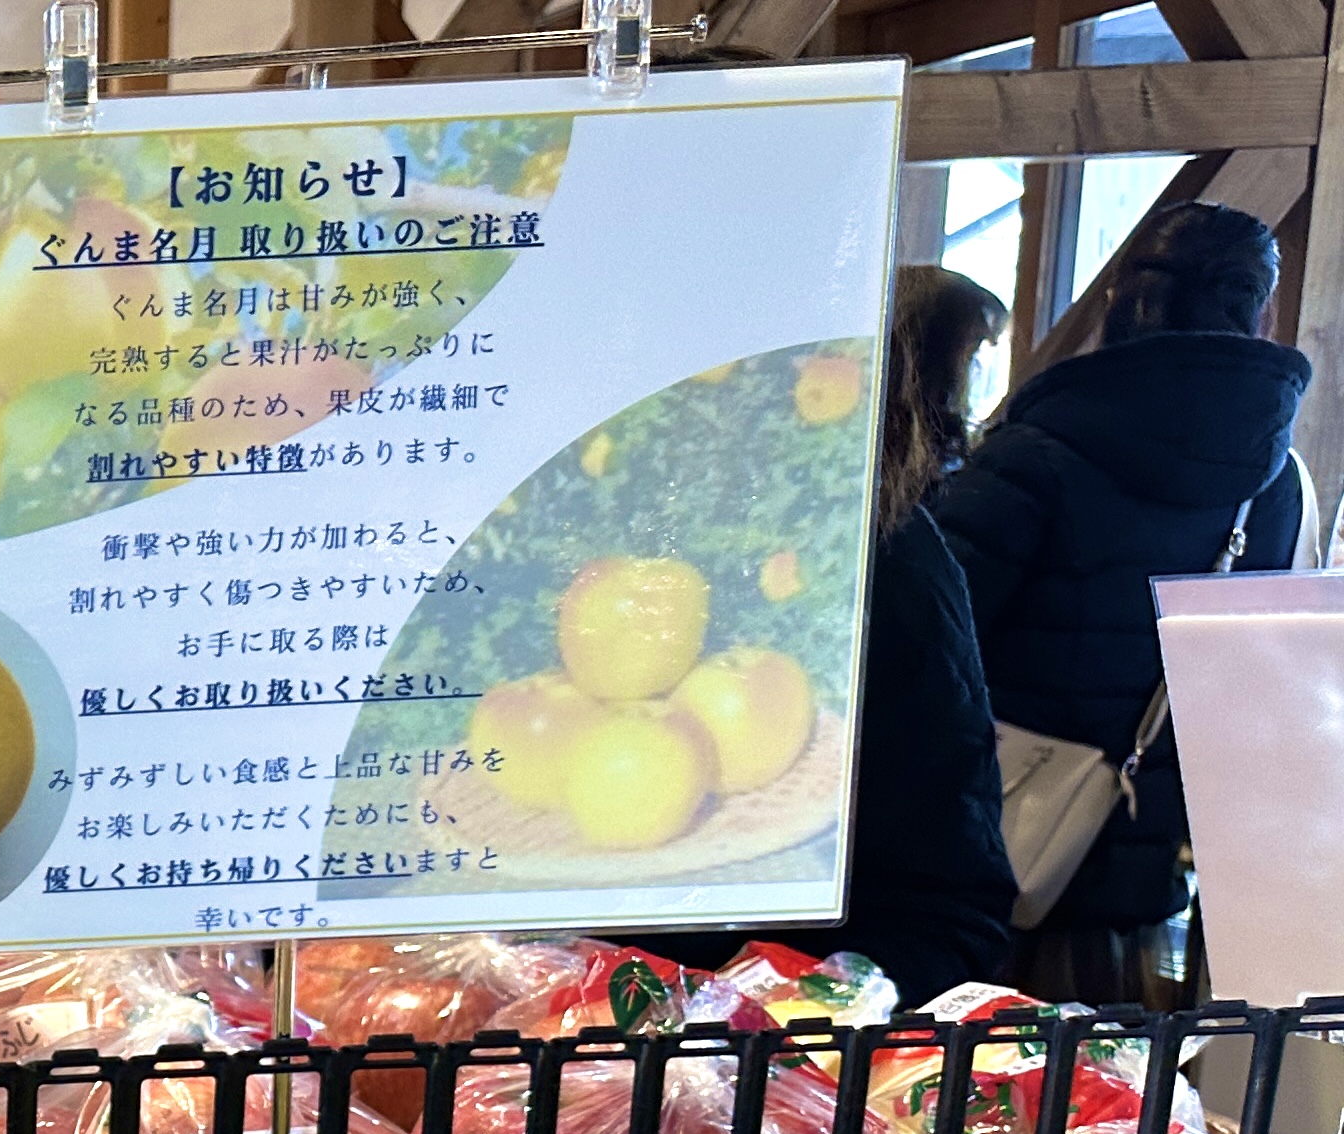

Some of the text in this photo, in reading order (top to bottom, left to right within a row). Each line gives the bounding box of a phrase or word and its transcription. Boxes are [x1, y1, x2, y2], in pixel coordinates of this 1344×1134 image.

[169, 156, 408, 208] 【お知らせ】
[39, 210, 542, 267] ぐんま名月 取り扱いのご注意
[112, 278, 467, 321] ぐんま名月は甘みが強く、
[90, 333, 494, 376] 完熟すると果汁がたっぷりに
[74, 383, 510, 427] なる品種のため、果皮が繊細で
[86, 437, 477, 482] 割れやすい特徴があります。
[101, 518, 459, 562] 衝撃や強い力が加わると、
[69, 572, 487, 615] 割れやすく傷つきやすいため、
[177, 622, 389, 658] お手に取る際は
[80, 674, 468, 715] 優しくお取り扱いください。
[47, 747, 506, 793] みずみずしい食感と上品な甘みを
[77, 800, 460, 840] お楽しみいただくためにも、
[43, 846, 500, 891] 優しくお持ち帰りくださいますと
[195, 903, 332, 932] 幸いです。
